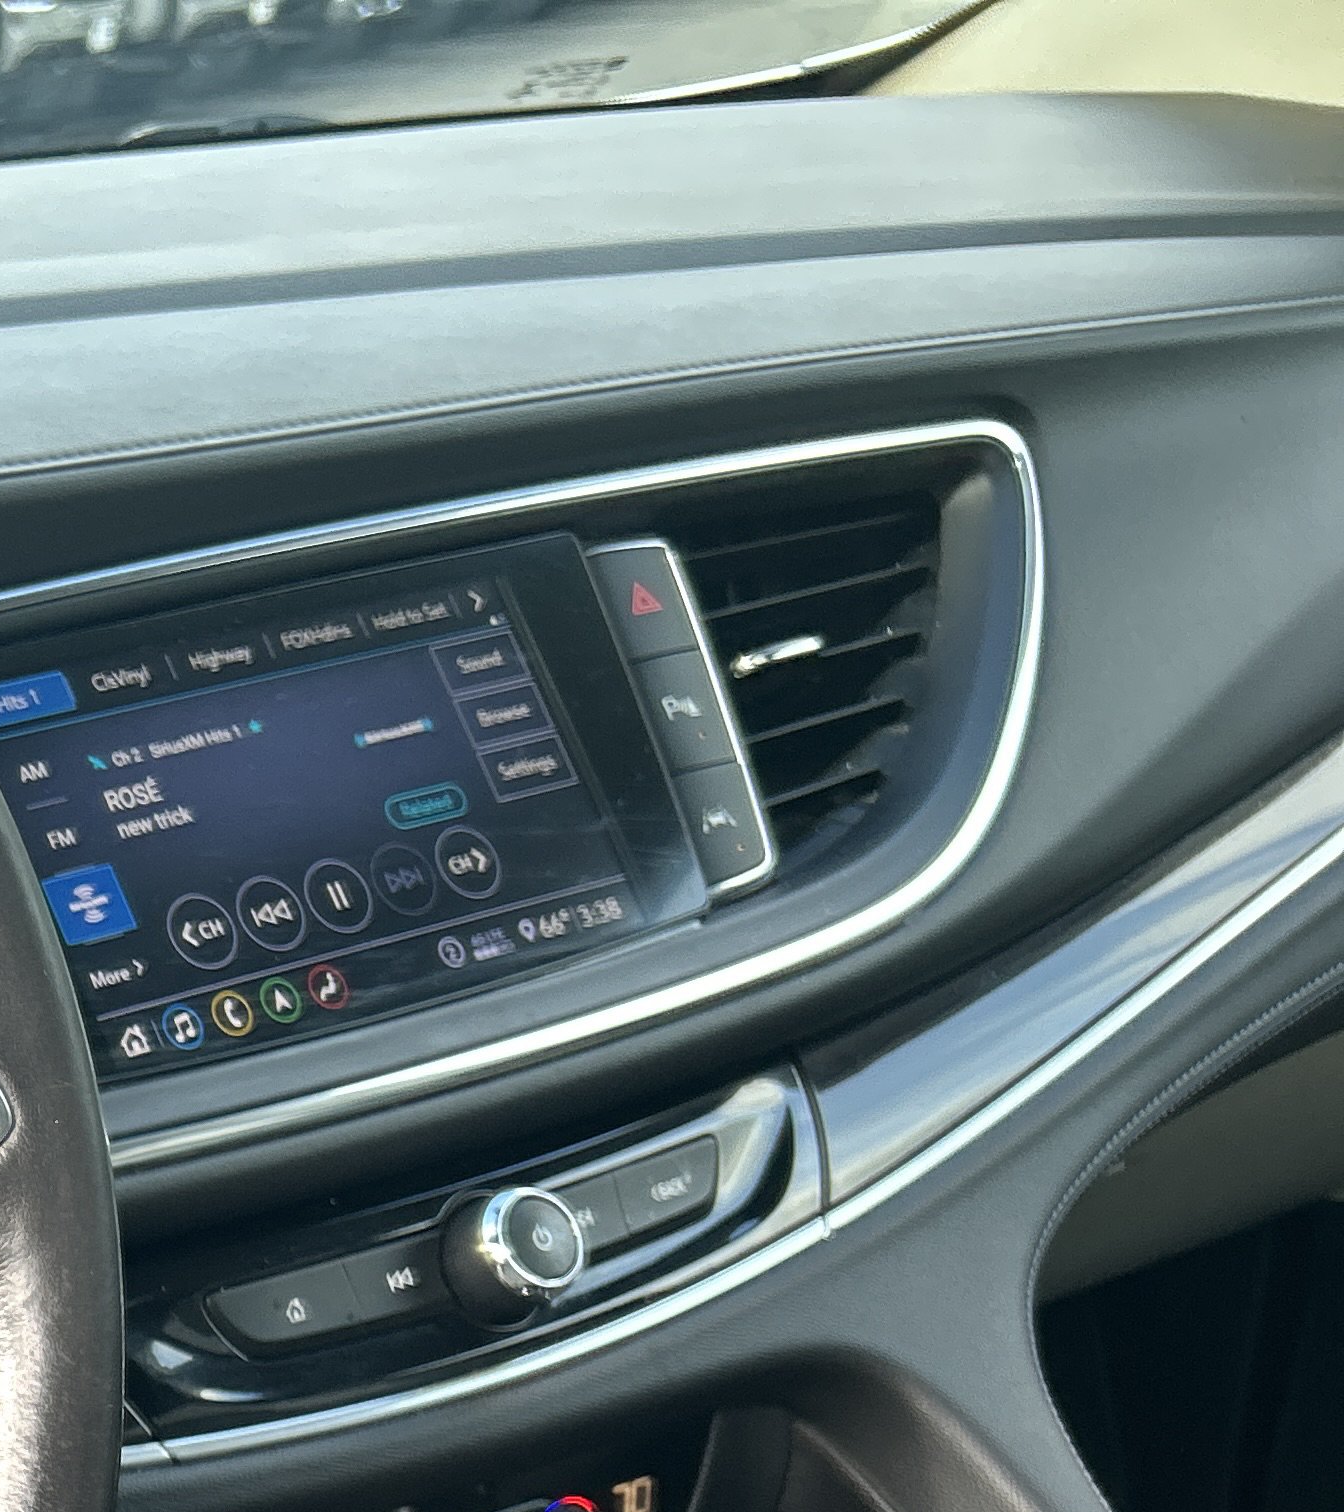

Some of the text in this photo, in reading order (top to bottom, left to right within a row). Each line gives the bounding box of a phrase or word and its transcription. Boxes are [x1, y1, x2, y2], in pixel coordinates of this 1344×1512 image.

[188, 645, 255, 673] Highway
[456, 647, 507, 675] Sound
[28, 688, 41, 706] 1
[476, 703, 532, 728] Browse
[111, 748, 132, 768] Ch
[131, 746, 145, 764] 2
[498, 754, 559, 781] Settings
[19, 760, 51, 784] AM
[116, 804, 196, 840] new trick
[46, 827, 79, 850] FM
[576, 896, 623, 929] 3:38
[198, 917, 226, 941] CH
[89, 967, 130, 990] More
